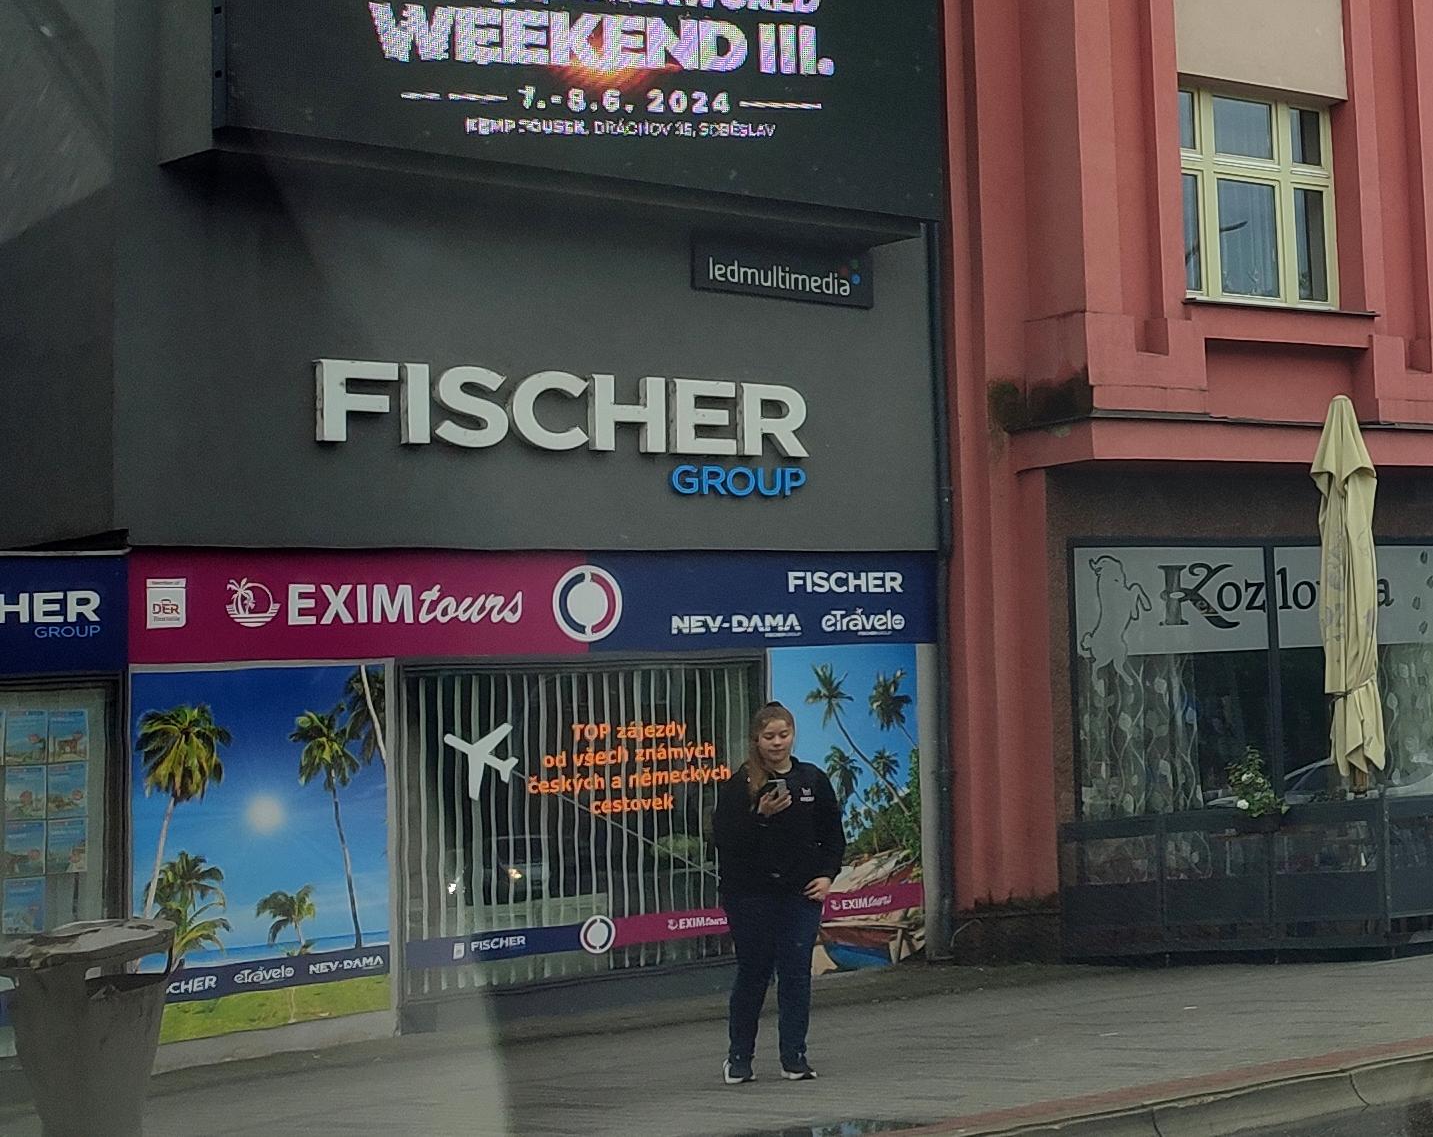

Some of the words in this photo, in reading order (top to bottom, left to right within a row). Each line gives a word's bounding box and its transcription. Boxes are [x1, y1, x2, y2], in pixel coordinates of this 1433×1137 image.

[368, 1, 748, 73] WEEKEND
[758, 22, 835, 76] III.
[647, 90, 731, 114] 2024
[465, 117, 516, 135] KEMP
[708, 256, 851, 296] ledmultimedia
[313, 358, 809, 458] FISCHER
[671, 464, 807, 498] GROUP
[787, 571, 903, 594] FISCHER
[1158, 562, 1395, 629] Kozloa
[34, 625, 101, 638] GROUP
[671, 613, 801, 634] NEV-DAMA
[572, 723, 611, 742] TOP
[616, 721, 687, 741] zájezdy
[543, 751, 566, 768] od
[573, 745, 628, 767] všech
[635, 741, 715, 762] známých
[528, 774, 604, 795] českých
[611, 776, 622, 789] a
[628, 765, 732, 788] německých
[590, 793, 674, 814] cestovek
[470, 935, 527, 952] FISCHER
[308, 955, 384, 974] NEV-DAMA
